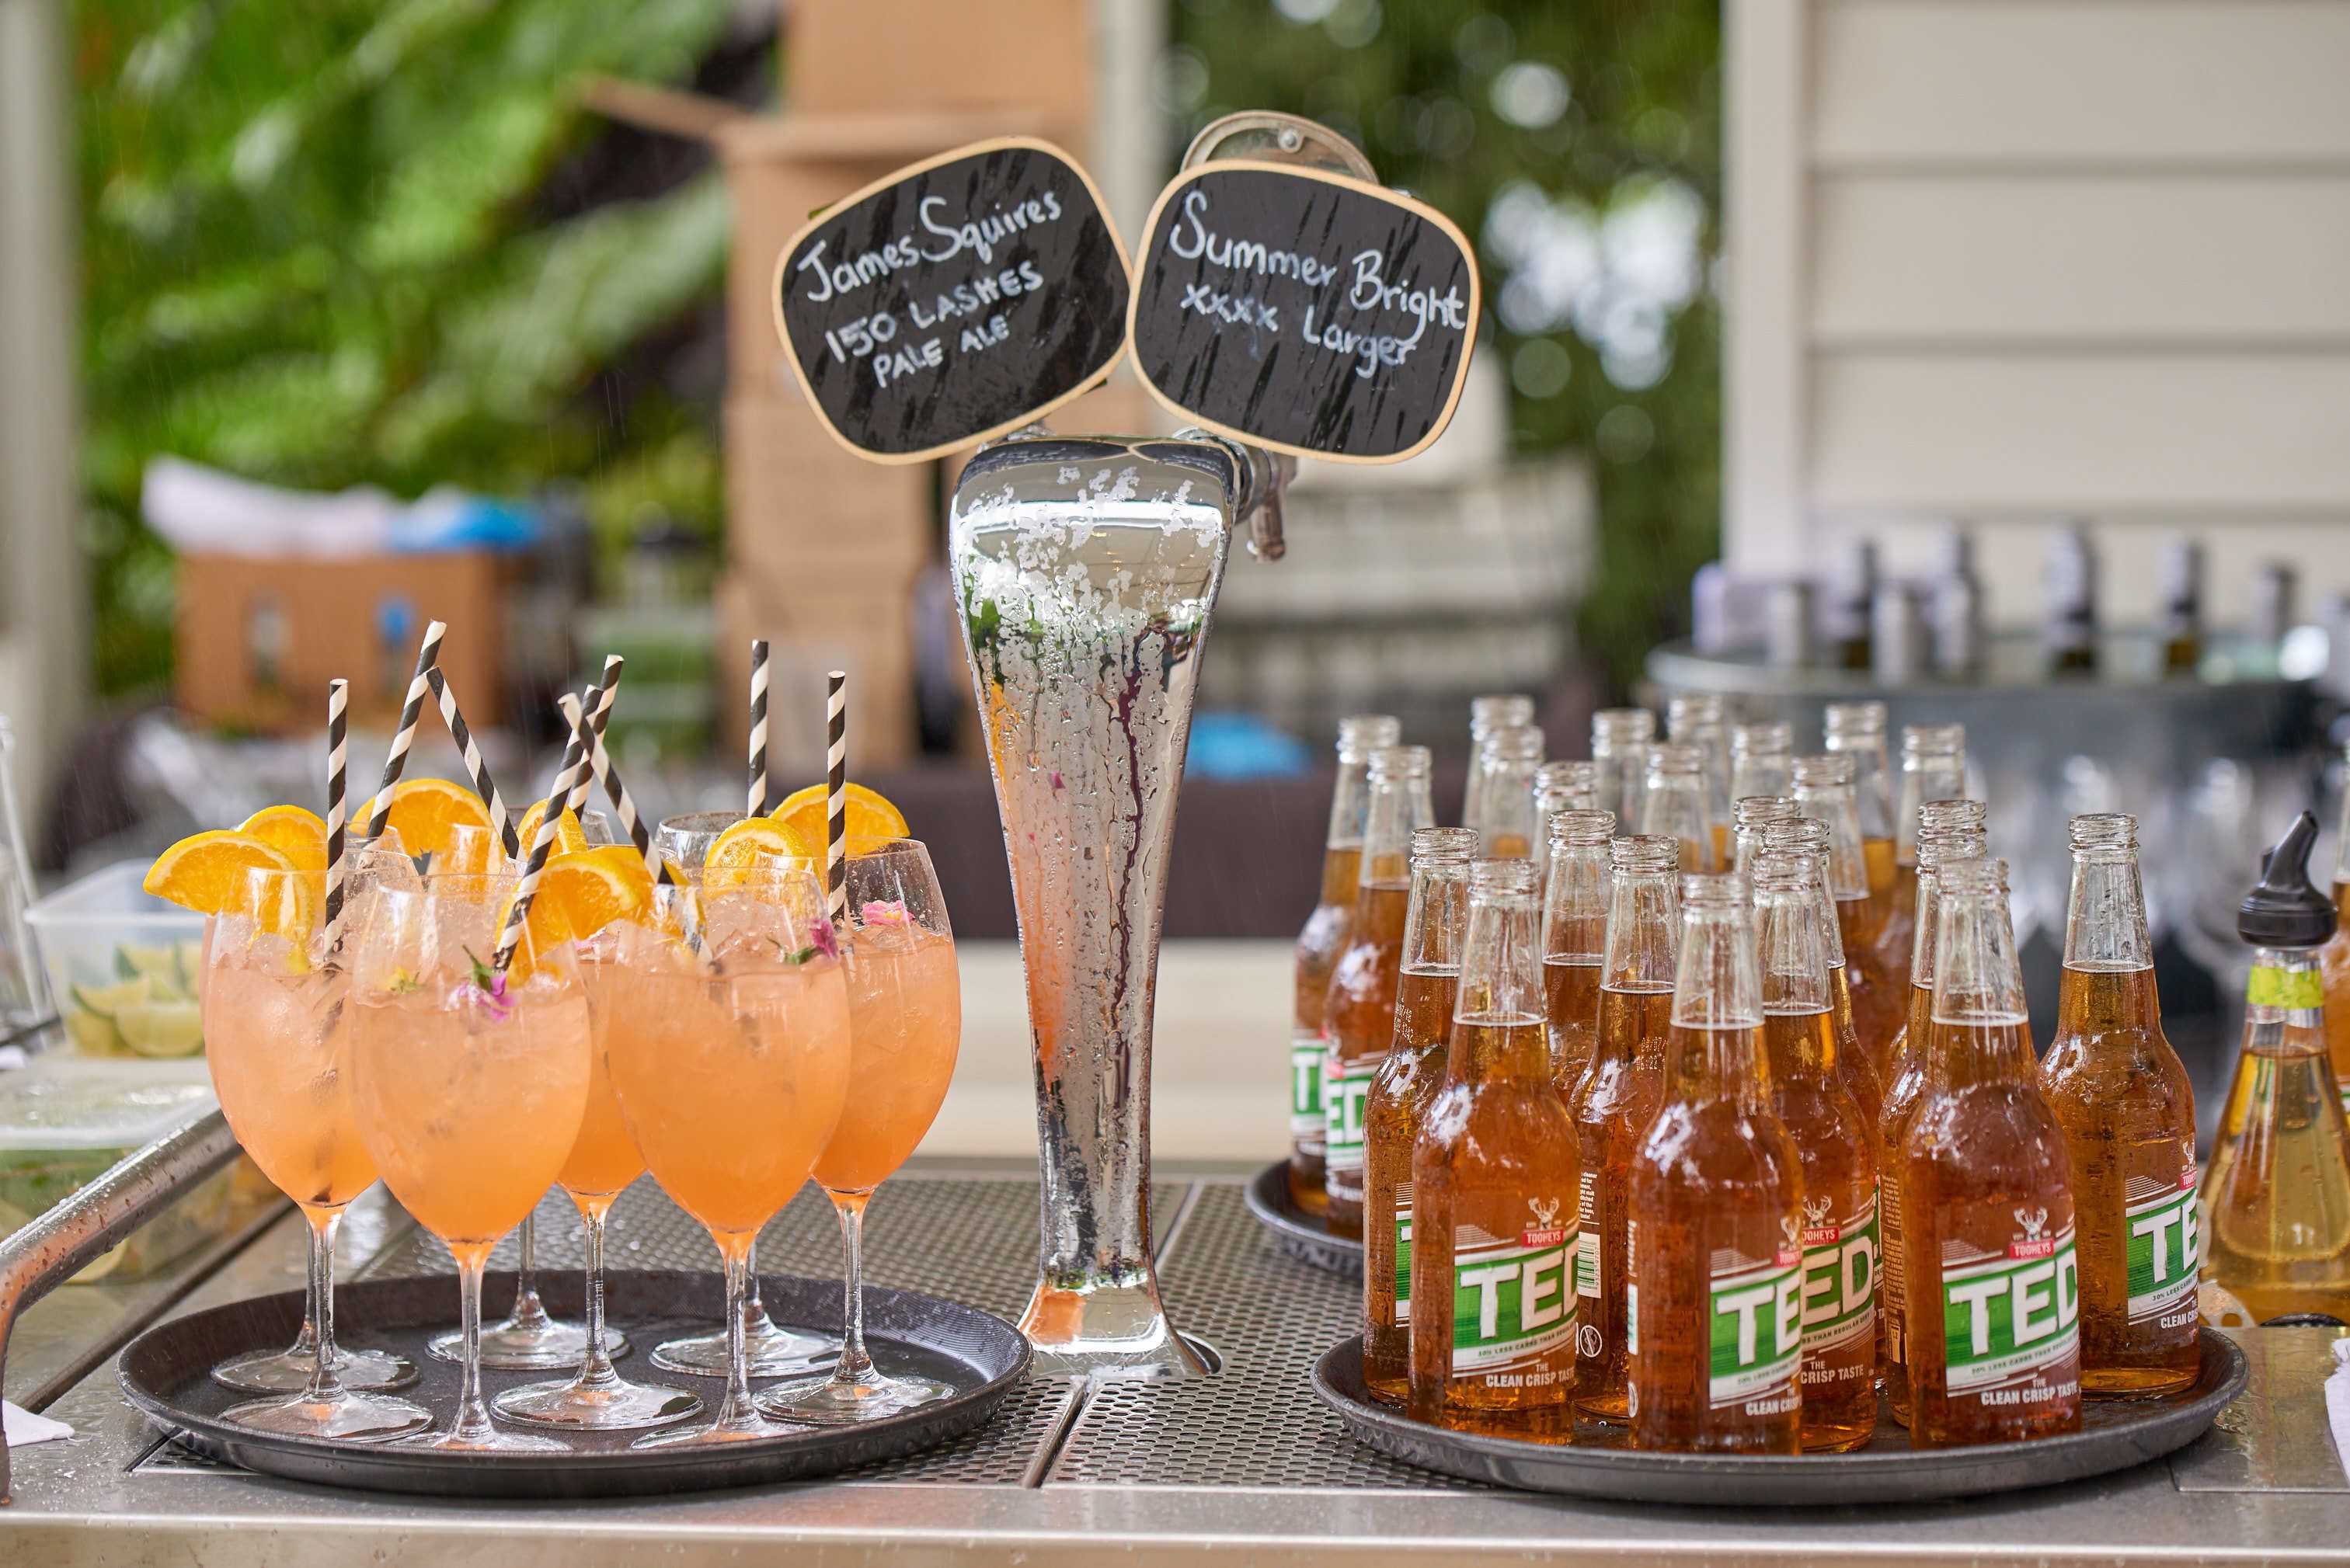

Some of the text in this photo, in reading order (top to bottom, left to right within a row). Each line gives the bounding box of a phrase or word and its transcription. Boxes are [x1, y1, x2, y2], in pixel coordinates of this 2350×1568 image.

[797, 191, 1062, 302] James Squires
[1170, 189, 1466, 345] Summer Bright
[825, 260, 1044, 363] 150 LASHES
[1303, 305, 1417, 378] Larger
[873, 315, 1010, 388] PALE ALE
[1527, 1231, 1561, 1244] TOOHEYS
[2160, 1312, 2187, 1330] CLEAN
[1536, 1363, 1549, 1373] THE
[1801, 1369, 1836, 1385] CRISP
[1838, 1364, 1864, 1381] TASTE
[1810, 1361, 1826, 1370] THE
[1485, 1374, 1523, 1388] CLEAN
[1525, 1372, 1557, 1387] CRISP
[2032, 1378, 2046, 1388] THE
[1981, 1381, 2078, 1406] CLEAN CRISP TASTE
[1745, 1399, 1780, 1417] CLEAN
